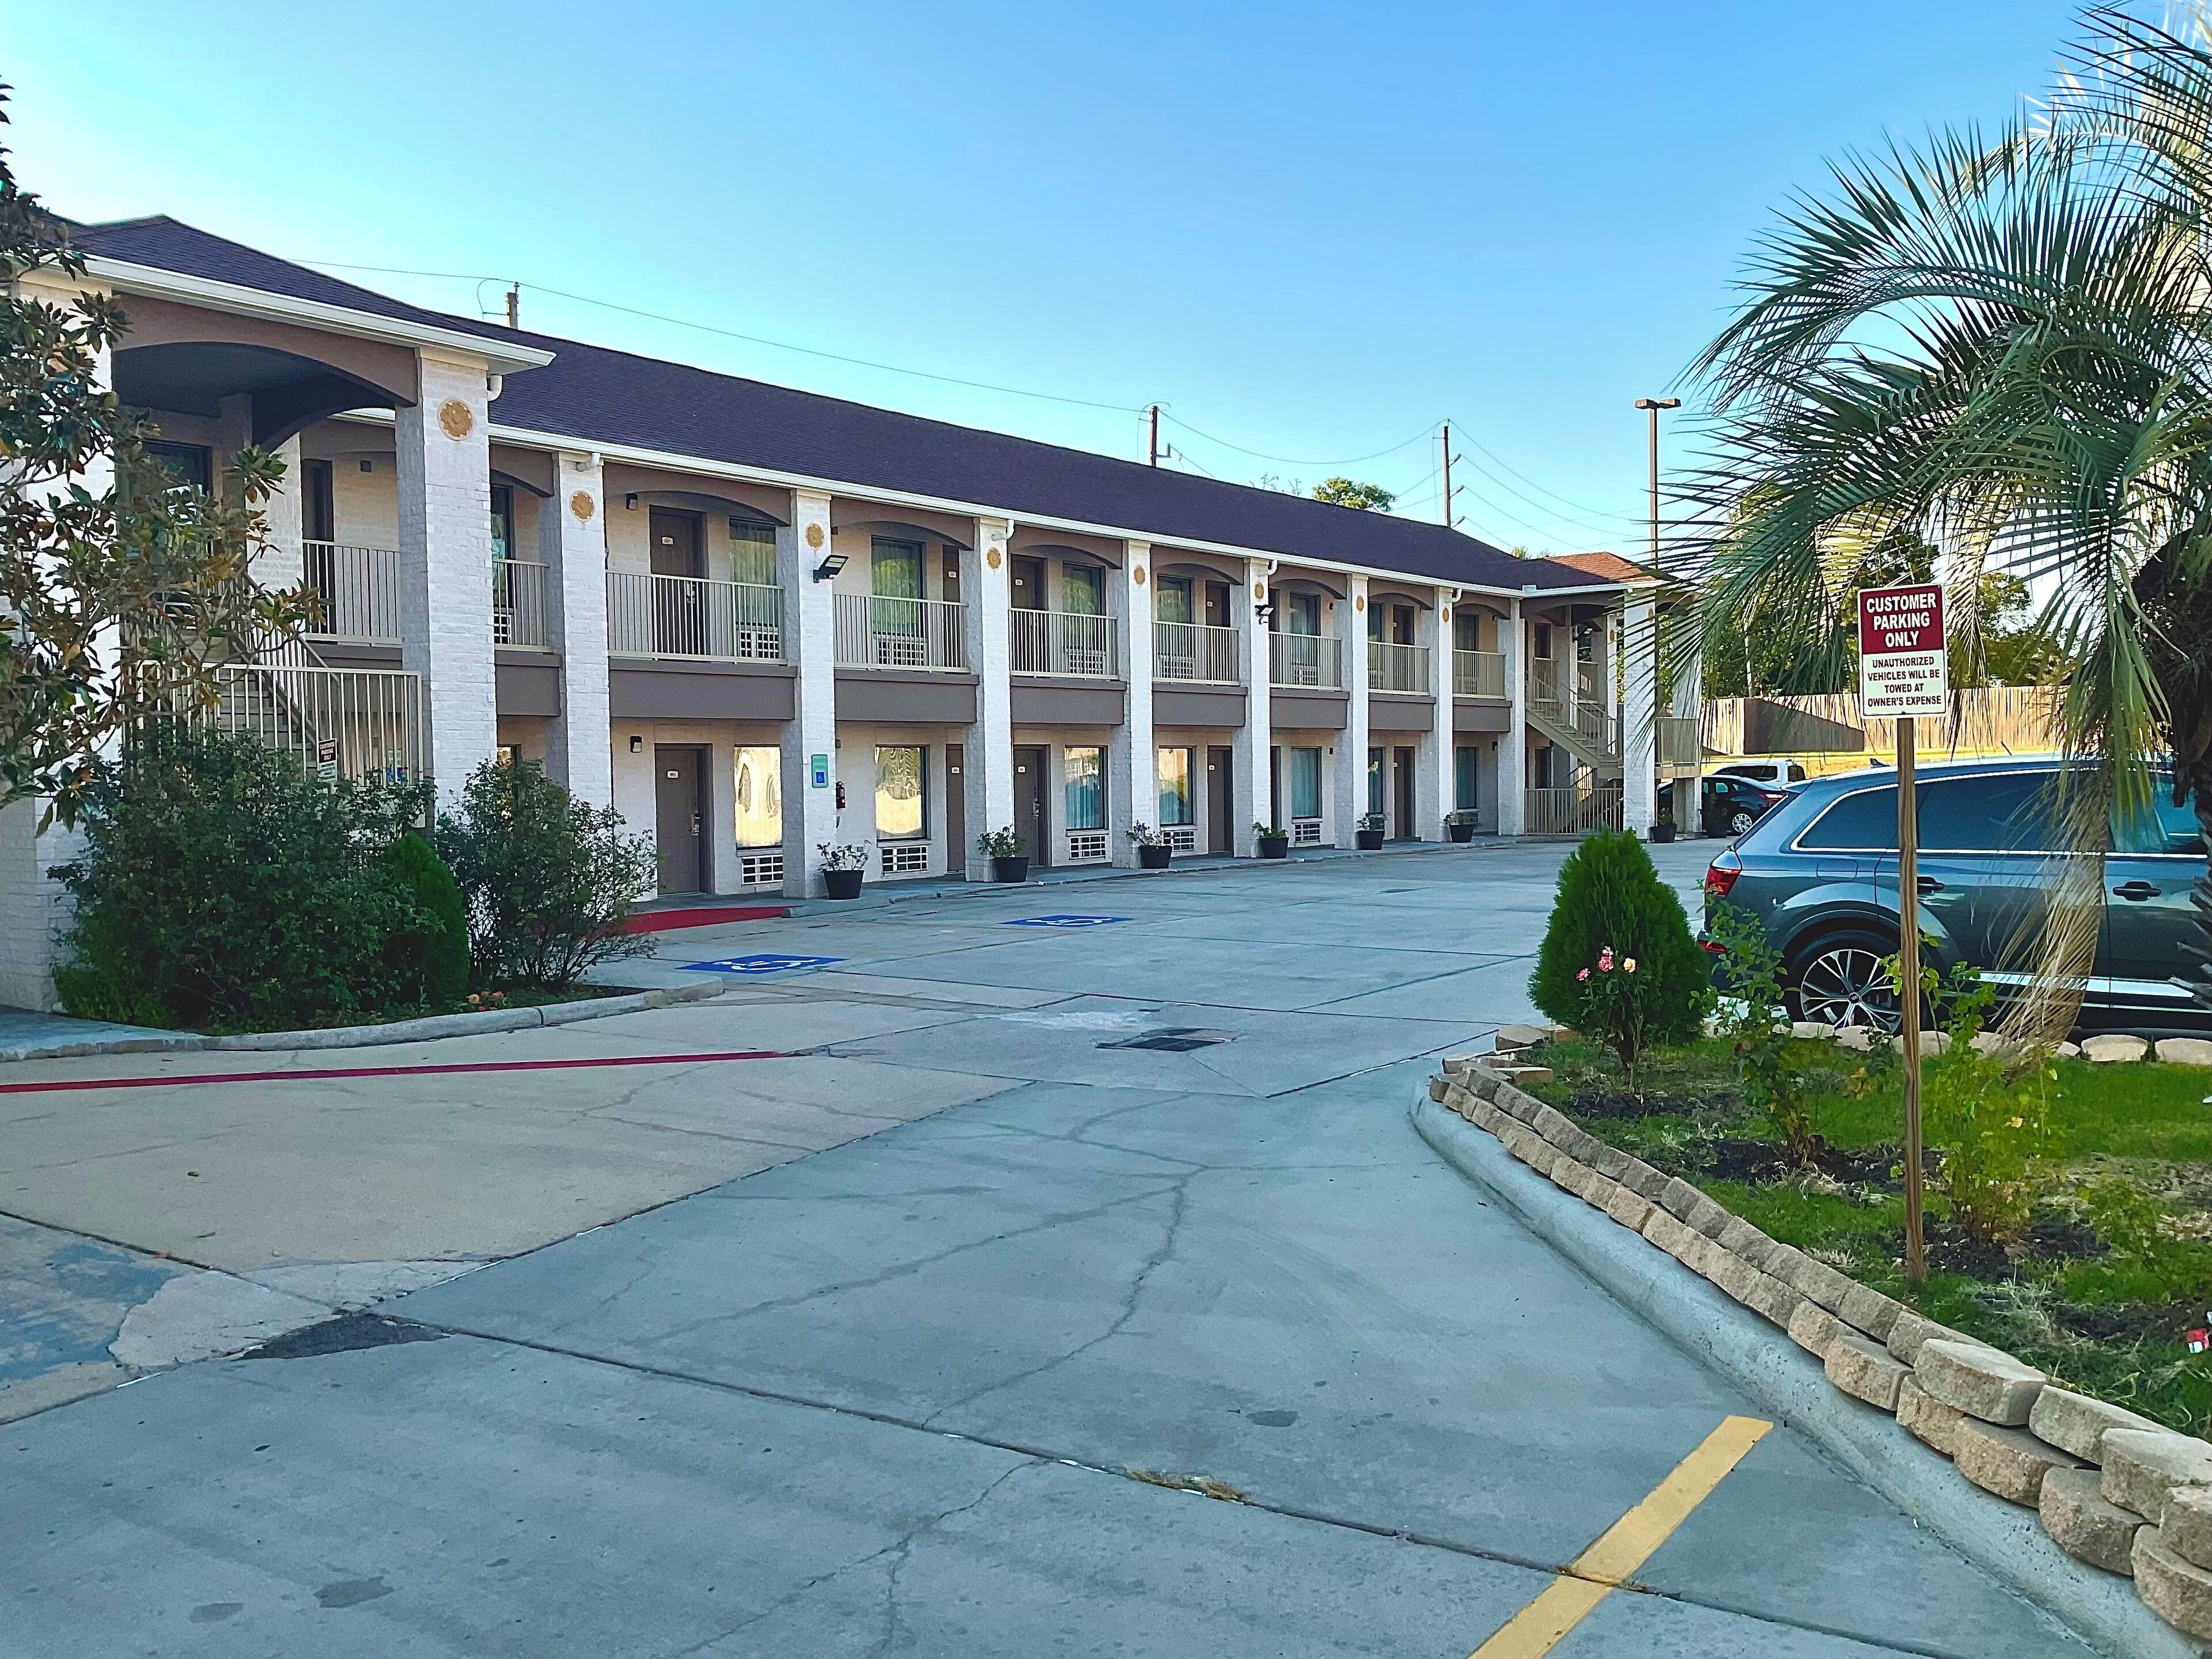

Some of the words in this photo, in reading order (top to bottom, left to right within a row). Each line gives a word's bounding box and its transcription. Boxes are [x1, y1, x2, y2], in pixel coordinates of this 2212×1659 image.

[1866, 593, 1937, 613] CUSTOMER
[1873, 611, 1930, 630] PARKING
[1885, 631, 1919, 647] ONLY
[1872, 656, 1934, 668] UNAUTHORIZED
[1867, 671, 1906, 681] VEHICLES
[1908, 669, 1927, 679] WILL
[1929, 669, 1940, 678] BE
[1884, 684, 1912, 693] TOWED
[1914, 683, 1925, 692] AT
[1868, 697, 1904, 707] OWNER'S
[1906, 695, 1941, 705] EXPENSE
